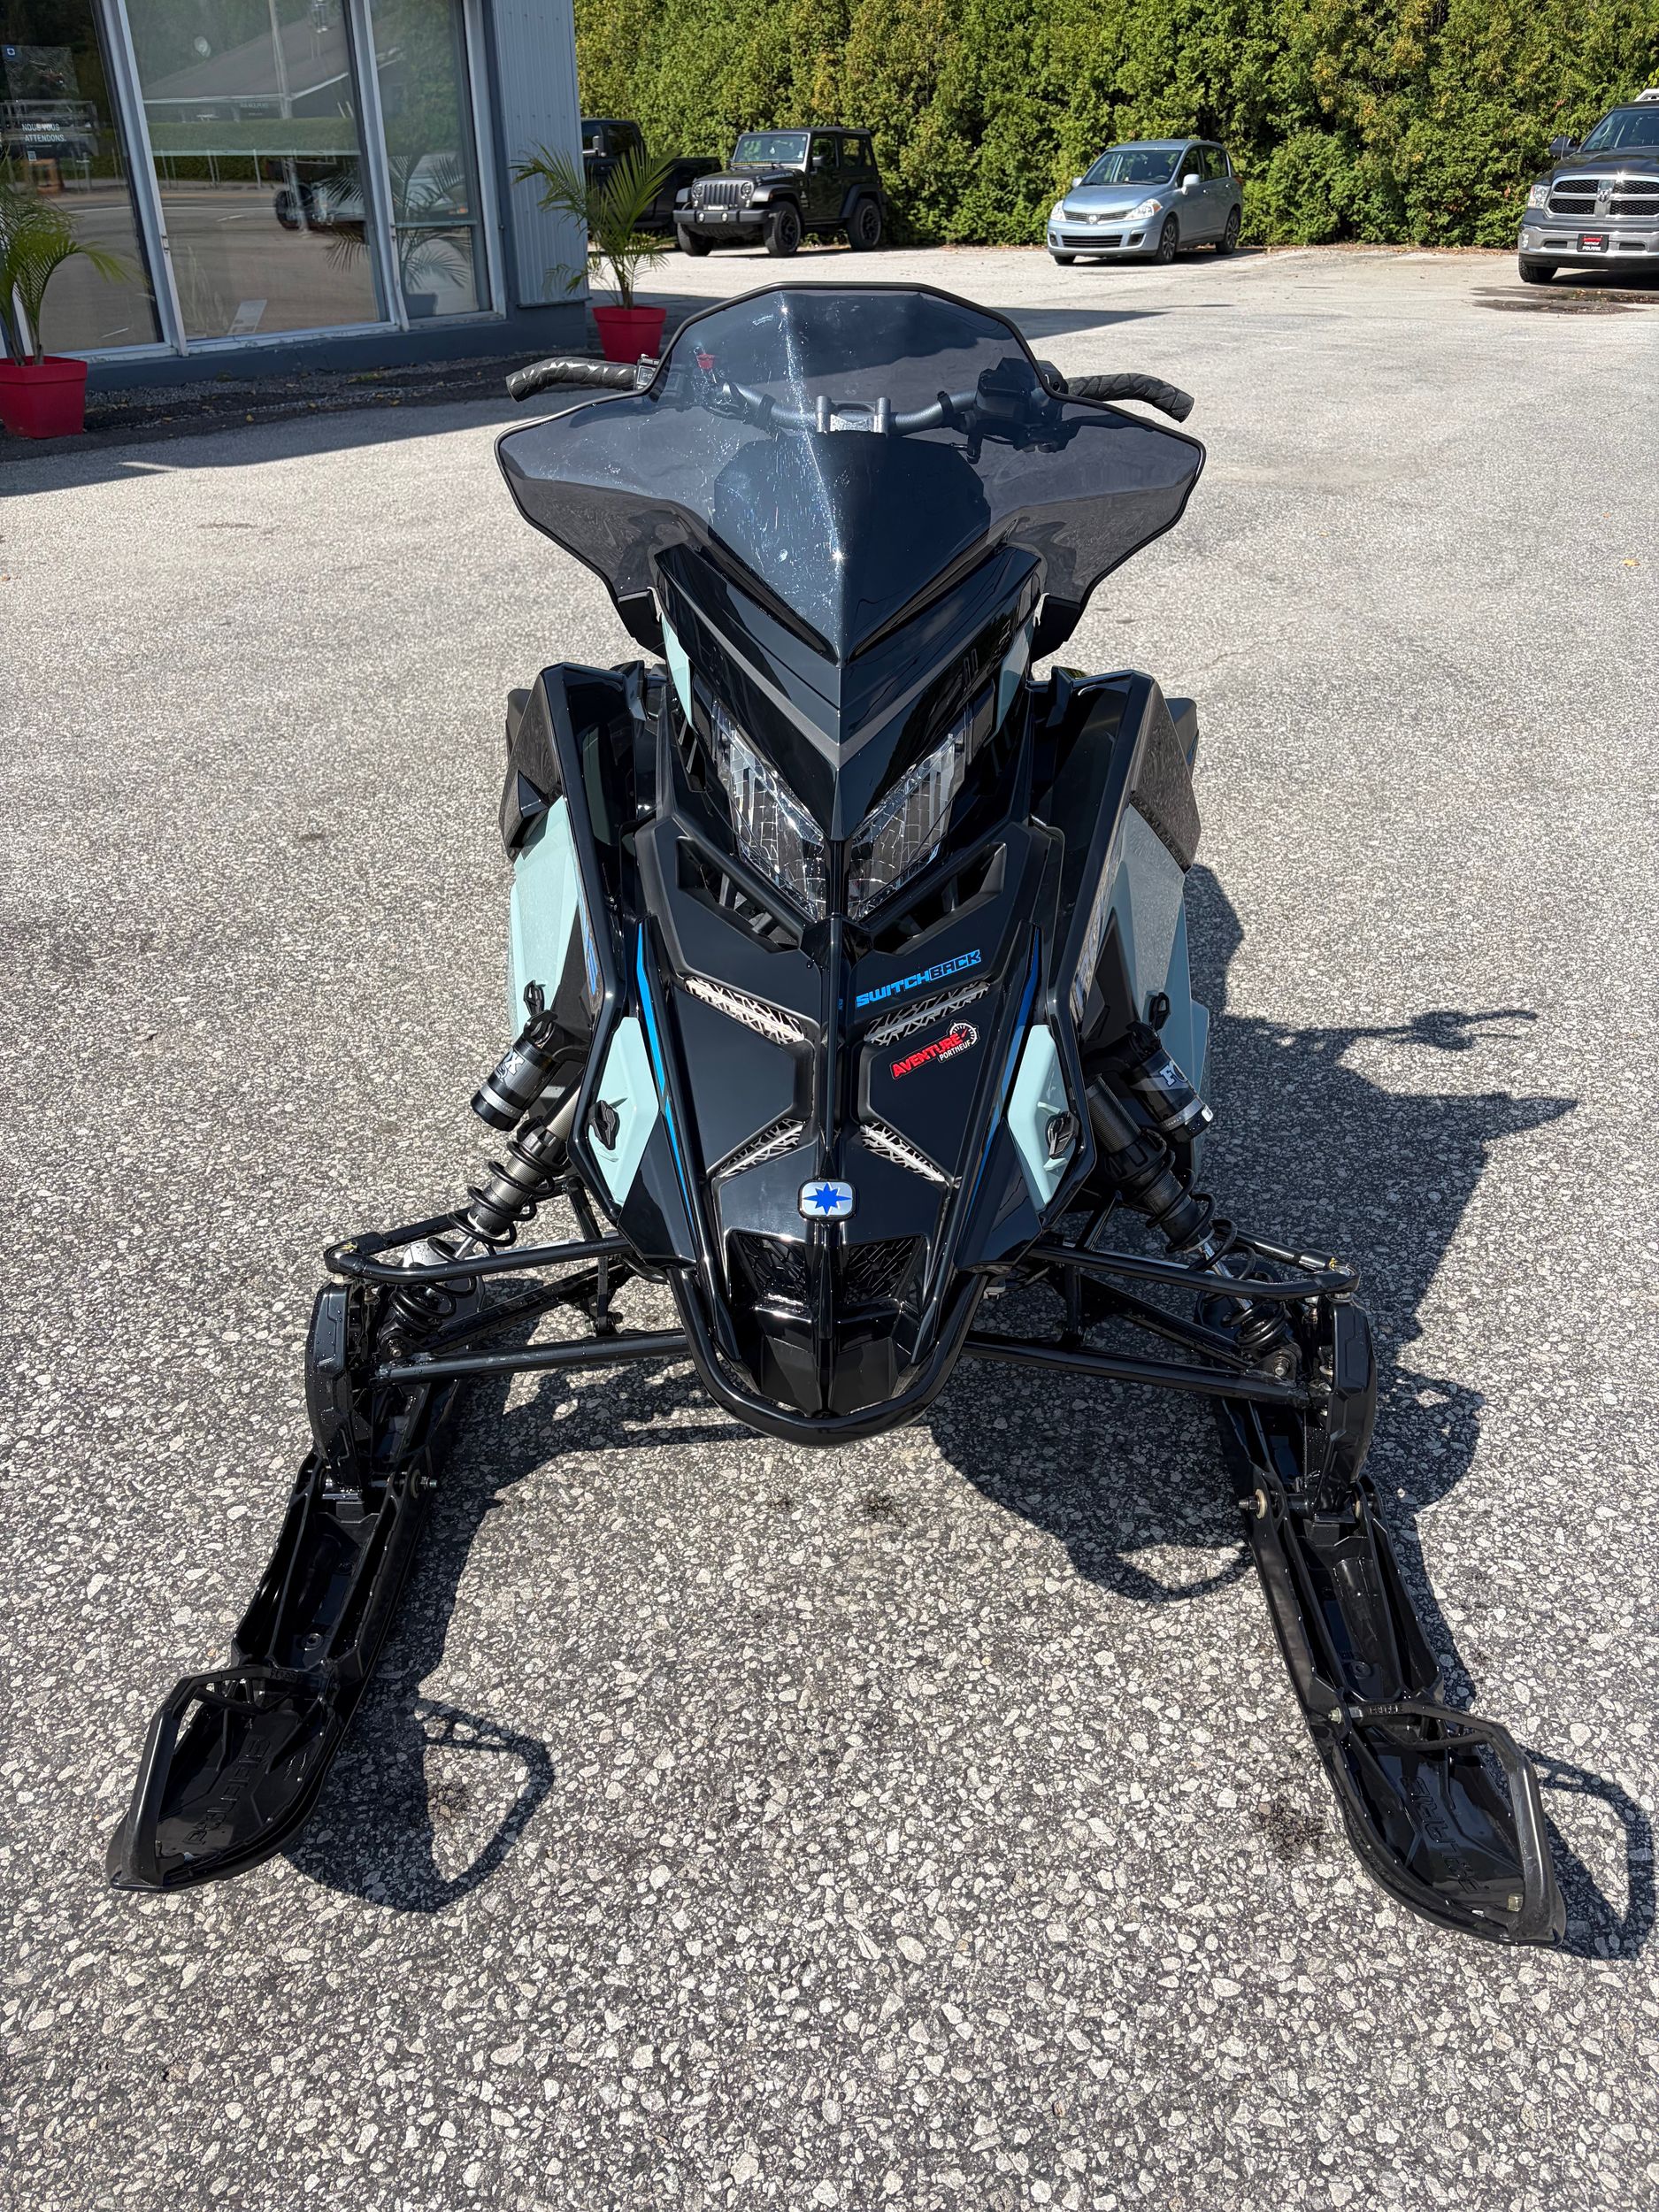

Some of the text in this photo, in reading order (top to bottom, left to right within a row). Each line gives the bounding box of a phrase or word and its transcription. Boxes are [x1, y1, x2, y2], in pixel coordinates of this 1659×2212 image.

[22, 123, 60, 132] NOUS VOUS
[856, 949, 982, 1010] SWITCHBACK
[892, 1033, 963, 1078] AVENTURE
[939, 1039, 972, 1061] PORTNEUF
